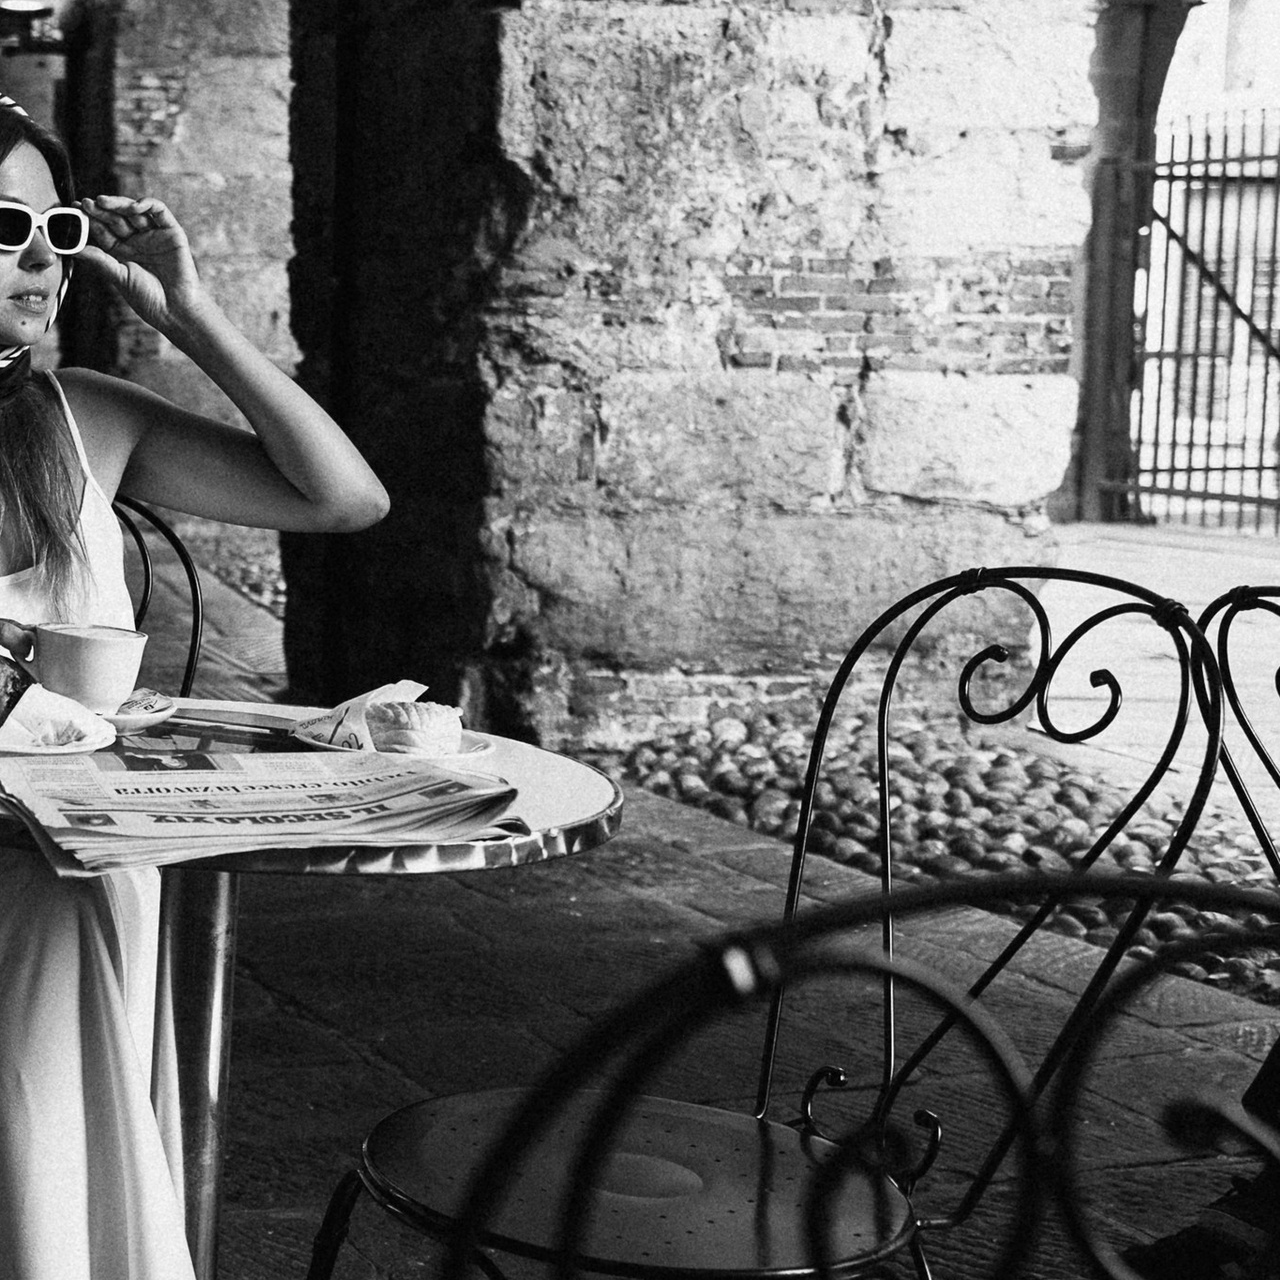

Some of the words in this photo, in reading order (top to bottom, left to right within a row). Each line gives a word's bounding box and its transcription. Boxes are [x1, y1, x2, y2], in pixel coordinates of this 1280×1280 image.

[113, 785, 214, 796] zavorra
[216, 784, 242, 794] la
[244, 782, 322, 791] cresce
[351, 804, 392, 813] IL
[145, 814, 214, 824] XIX
[214, 810, 352, 825] SECOLO
